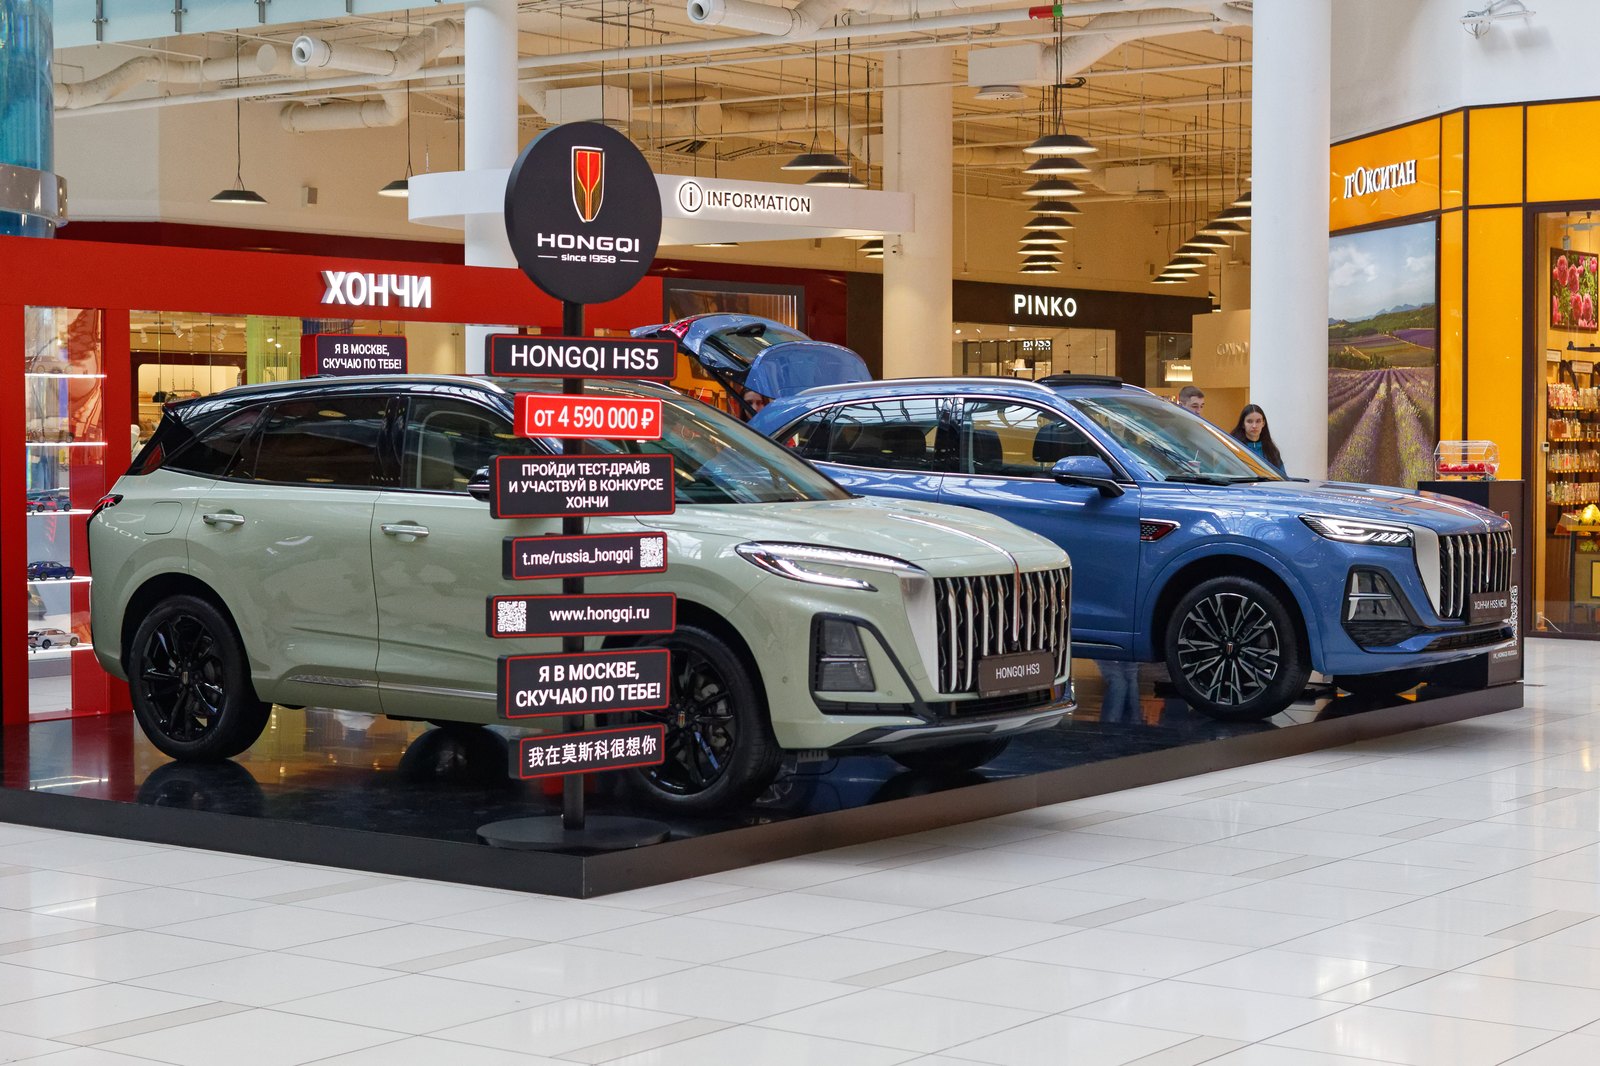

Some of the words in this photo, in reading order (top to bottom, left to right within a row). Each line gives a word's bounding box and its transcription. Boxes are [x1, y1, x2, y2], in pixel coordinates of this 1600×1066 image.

[707, 191, 811, 213] INFORMATION
[537, 233, 640, 253] HONGQI
[561, 253, 587, 263] since
[589, 254, 617, 263] 1958
[320, 270, 432, 309] ХОНЧИ
[1014, 294, 1078, 318] PINKO
[335, 344, 341, 354] Я
[343, 344, 349, 354] В
[351, 344, 390, 357] МОСКВЕ,
[511, 345, 606, 371] HONGQI
[612, 348, 659, 370] HS5
[323, 358, 362, 369] СКУЧАЮ
[364, 358, 377, 369] ПО
[378, 359, 402, 369] ТЕБЕ!
[534, 409, 555, 426] от
[558, 406, 570, 427] 4
[573, 406, 604, 428] 590
[608, 408, 638, 429] 000
[522, 462, 576, 478] ПРОЙДИ
[578, 460, 651, 477] ТЕСТ-ДРАЙВ
[509, 481, 518, 493] И
[521, 478, 586, 493] УЧАСТВУЙ
[589, 480, 598, 492] В
[600, 478, 664, 492] КОНКУРСЕ
[566, 496, 609, 508] ХОНЧИ
[522, 547, 634, 566] t.me/russia_hongqi
[549, 606, 650, 623] www.hongqi.ru
[539, 666, 550, 683] Я
[554, 665, 565, 681] В
[569, 661, 640, 681] МОСКВЕ,
[995, 665, 1025, 679] HONGQI
[1026, 663, 1040, 675] HS3
[516, 688, 588, 707] СКУЧАЮ
[592, 685, 615, 703] ПО
[617, 683, 661, 701] ТЕБЕ!
[528, 735, 657, 768] 我在莫斯科很想你
